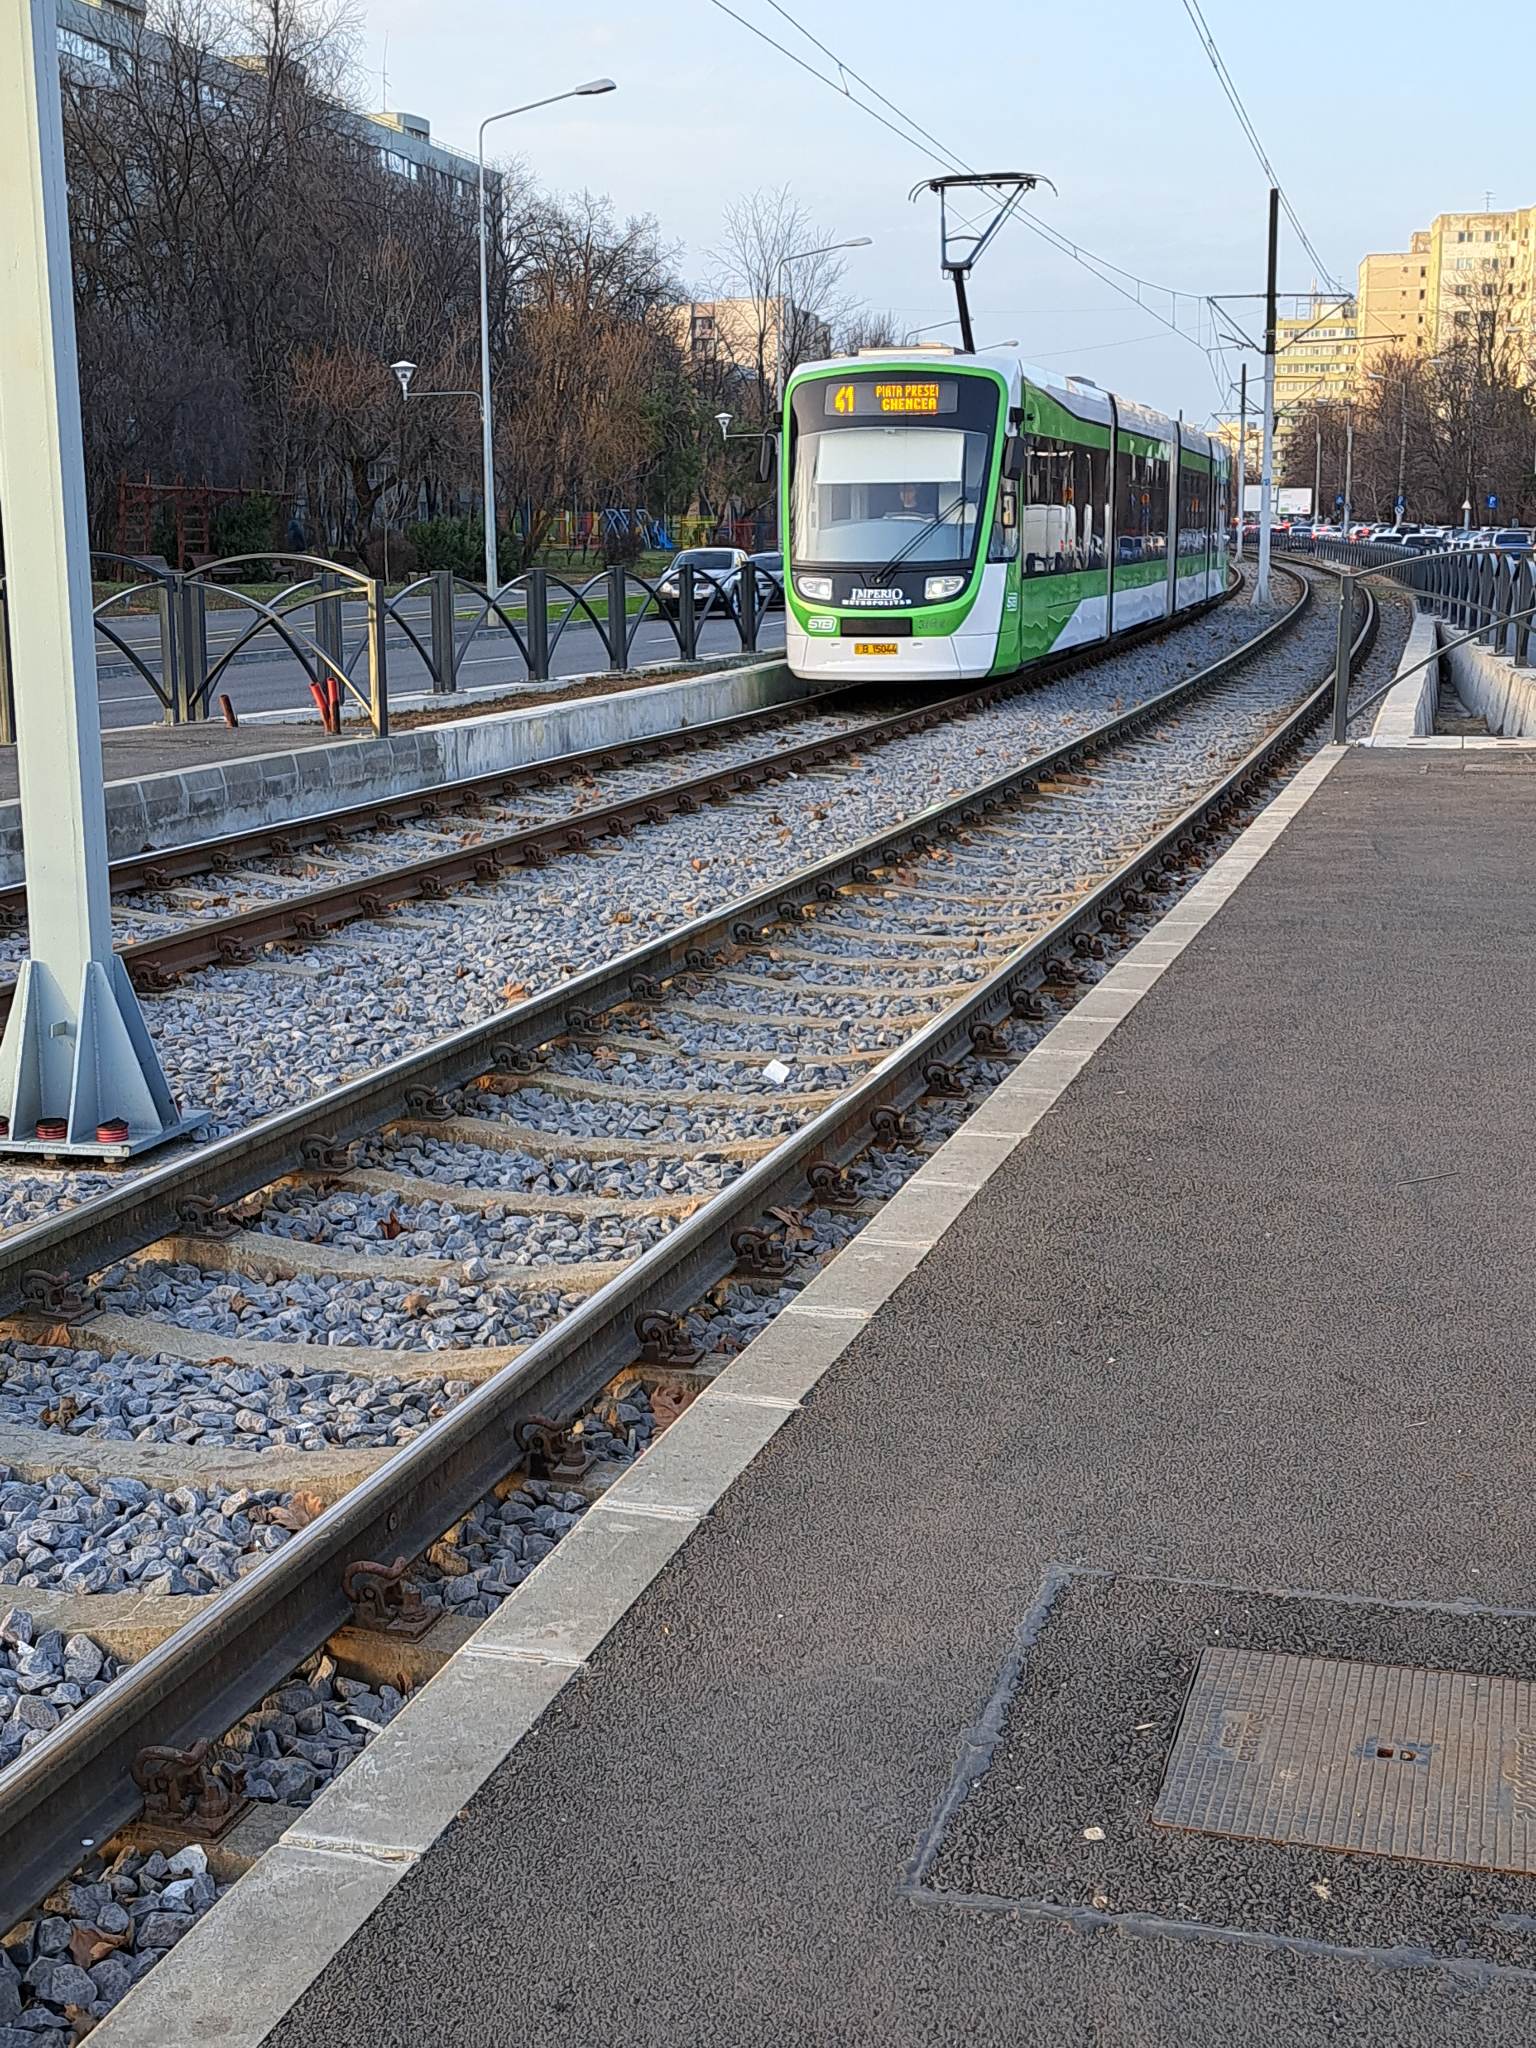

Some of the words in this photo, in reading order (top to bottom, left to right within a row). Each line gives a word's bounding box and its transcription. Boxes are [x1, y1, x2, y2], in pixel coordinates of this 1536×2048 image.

[875, 384, 902, 398] PIATA
[835, 385, 855, 412] 41
[881, 398, 937, 411] GHENCEA
[851, 588, 904, 600] IMPERIO
[808, 618, 834, 630] STB
